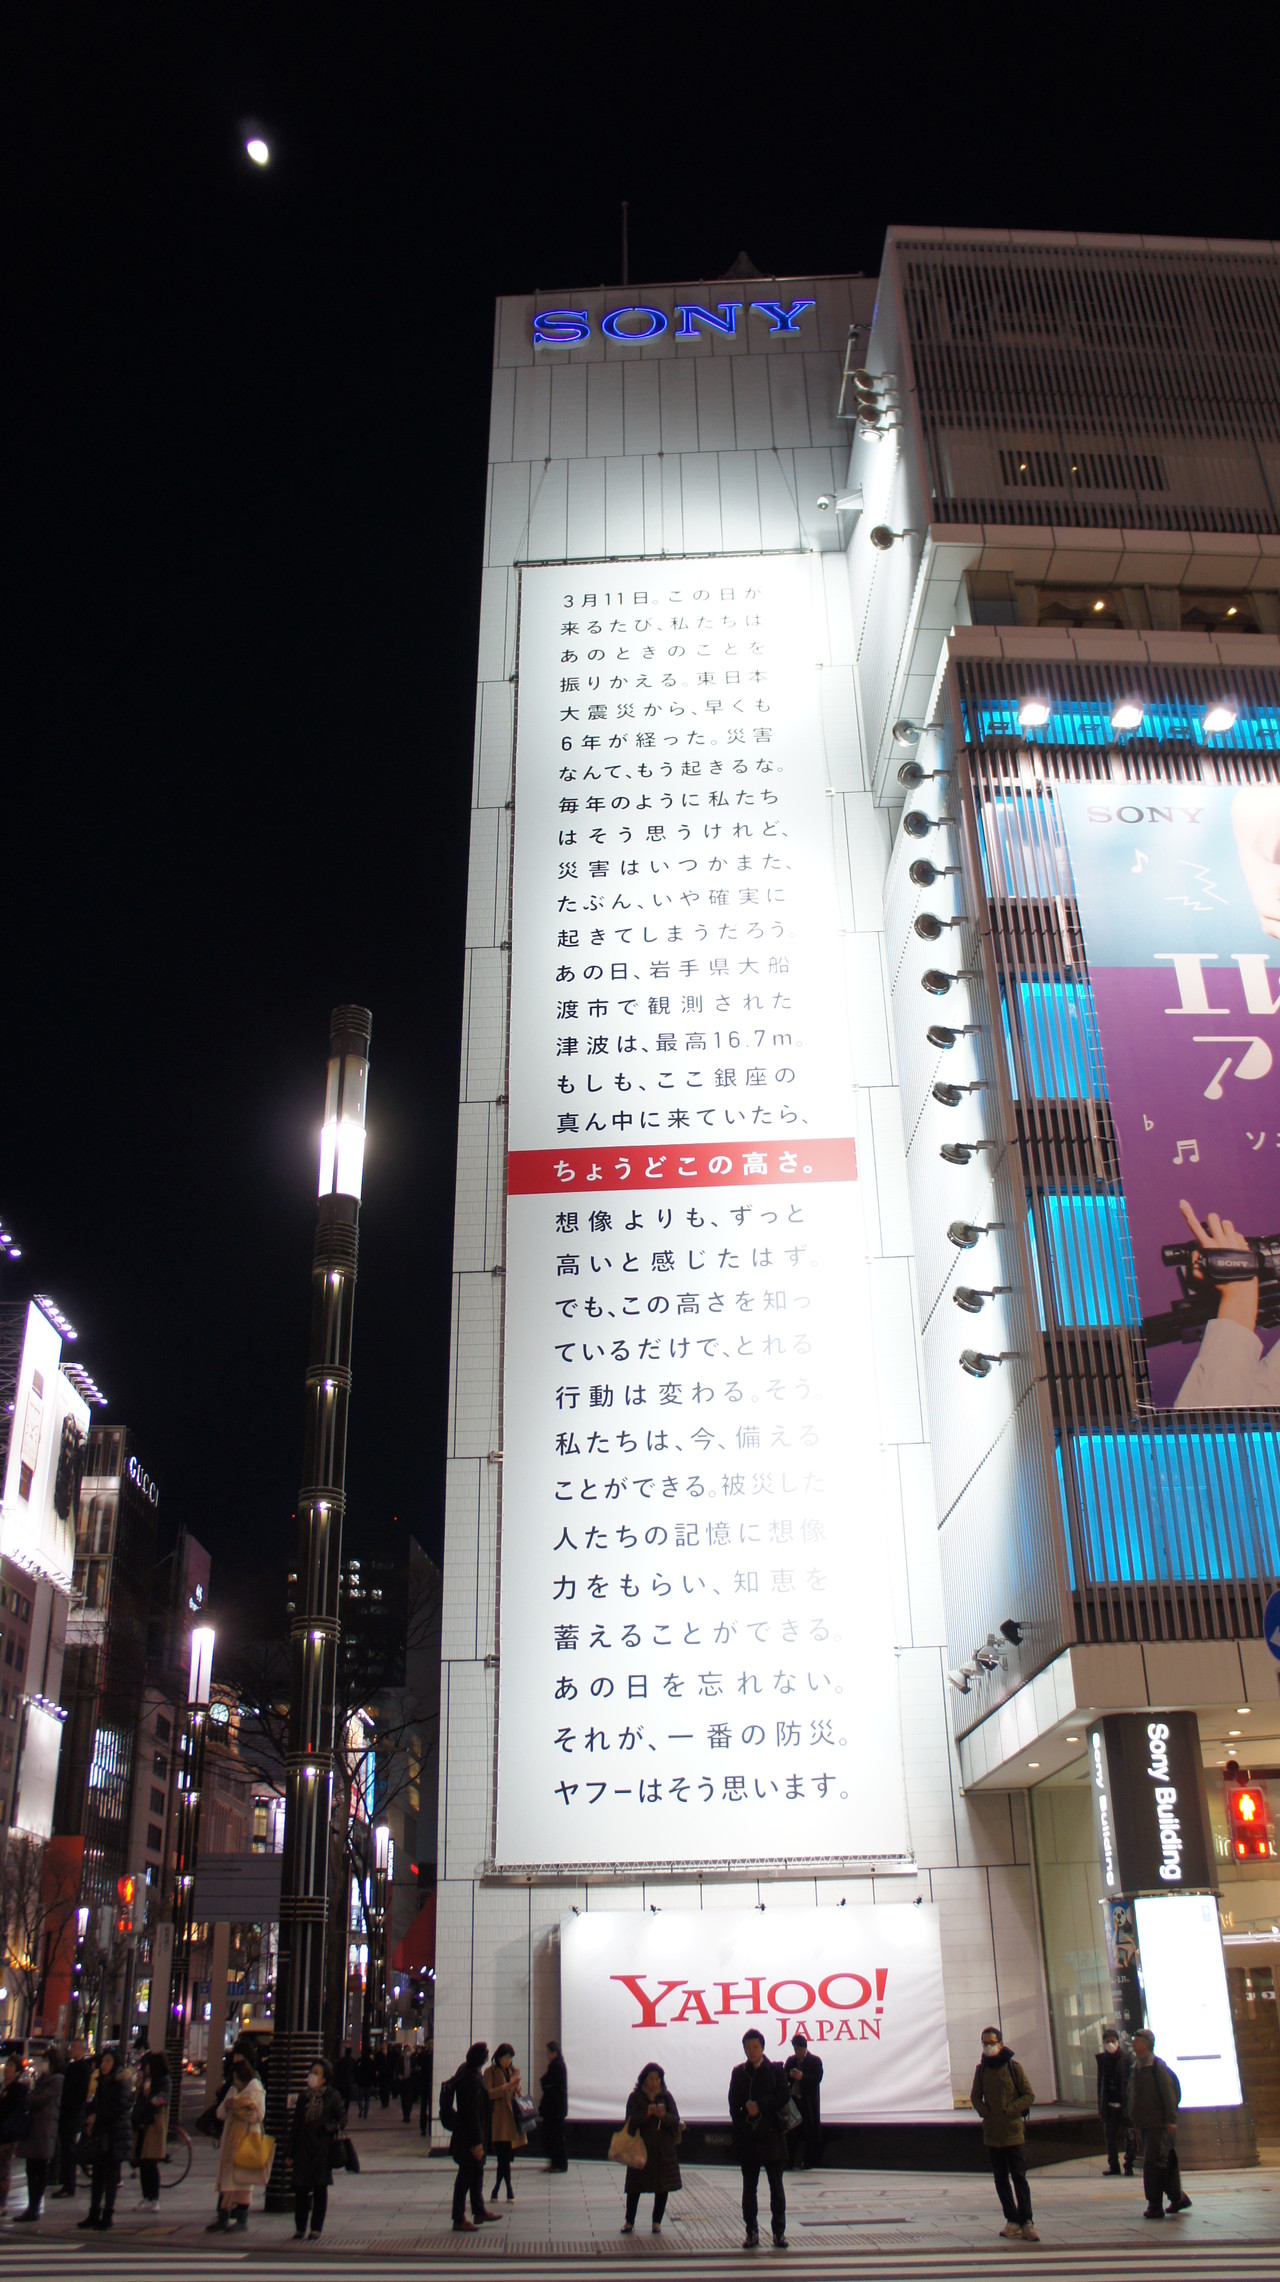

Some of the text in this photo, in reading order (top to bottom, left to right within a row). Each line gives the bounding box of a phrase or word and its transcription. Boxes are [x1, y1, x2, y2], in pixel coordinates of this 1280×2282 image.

[533, 299, 816, 349] SONY
[564, 586, 762, 609] 3月11日。この日が
[560, 613, 762, 637] 来るたび、私たちは
[560, 640, 765, 664] あのときのことを
[559, 670, 768, 693] 振りかえる。東日本
[559, 699, 771, 722] 大震災から、早くも
[561, 727, 773, 751] 6年が経った。災害
[558, 757, 784, 782] なんて、もう起きるな。
[558, 788, 779, 814] 毎年のように私たち
[1087, 805, 1206, 824] SONY
[558, 820, 789, 846] はそう思うけれど、
[557, 853, 792, 880] 災害はいつかまた、
[557, 887, 785, 913] たぶん、いや確実に
[555, 956, 790, 983] あの日、岩手県大船
[556, 991, 793, 1020] 渡市で観測された
[555, 1029, 803, 1056] 津波は、最高16.7m。
[557, 1066, 796, 1094] もしも、ここ銀座の
[556, 1105, 808, 1134] 真ん中に来ていたら、
[1246, 1131, 1280, 1151] ソ
[552, 1149, 815, 1182] ちょうどこの高さ。
[555, 1203, 805, 1233] 想像よりも、ずっと
[556, 1244, 818, 1276] 高いと感じたはず。
[1216, 1258, 1249, 1268] SONY
[554, 1289, 811, 1319] でも、この高さを知っ
[554, 1333, 812, 1362] ているだけで、とれる
[555, 1424, 820, 1456] 私たちは、今、備える
[129, 1456, 160, 1507] GUCCI
[554, 1470, 826, 1501] ことができる。被災した
[553, 1516, 827, 1551] 人たちの記憶に想像
[552, 1566, 828, 1600] 力をもらい、知恵を
[553, 1617, 842, 1651] 蓄えることができる。
[554, 1668, 843, 1701] あの日を忘れない。
[554, 1718, 848, 1753] それが、一番の防災。
[553, 1771, 849, 1806] ヤフーはそう思います。
[1147, 1722, 1184, 1881] Sony Building
[1092, 1732, 1115, 1887] Sony Building
[609, 1967, 889, 2028] YAHOO!
[775, 2017, 882, 2046] JAPAN
